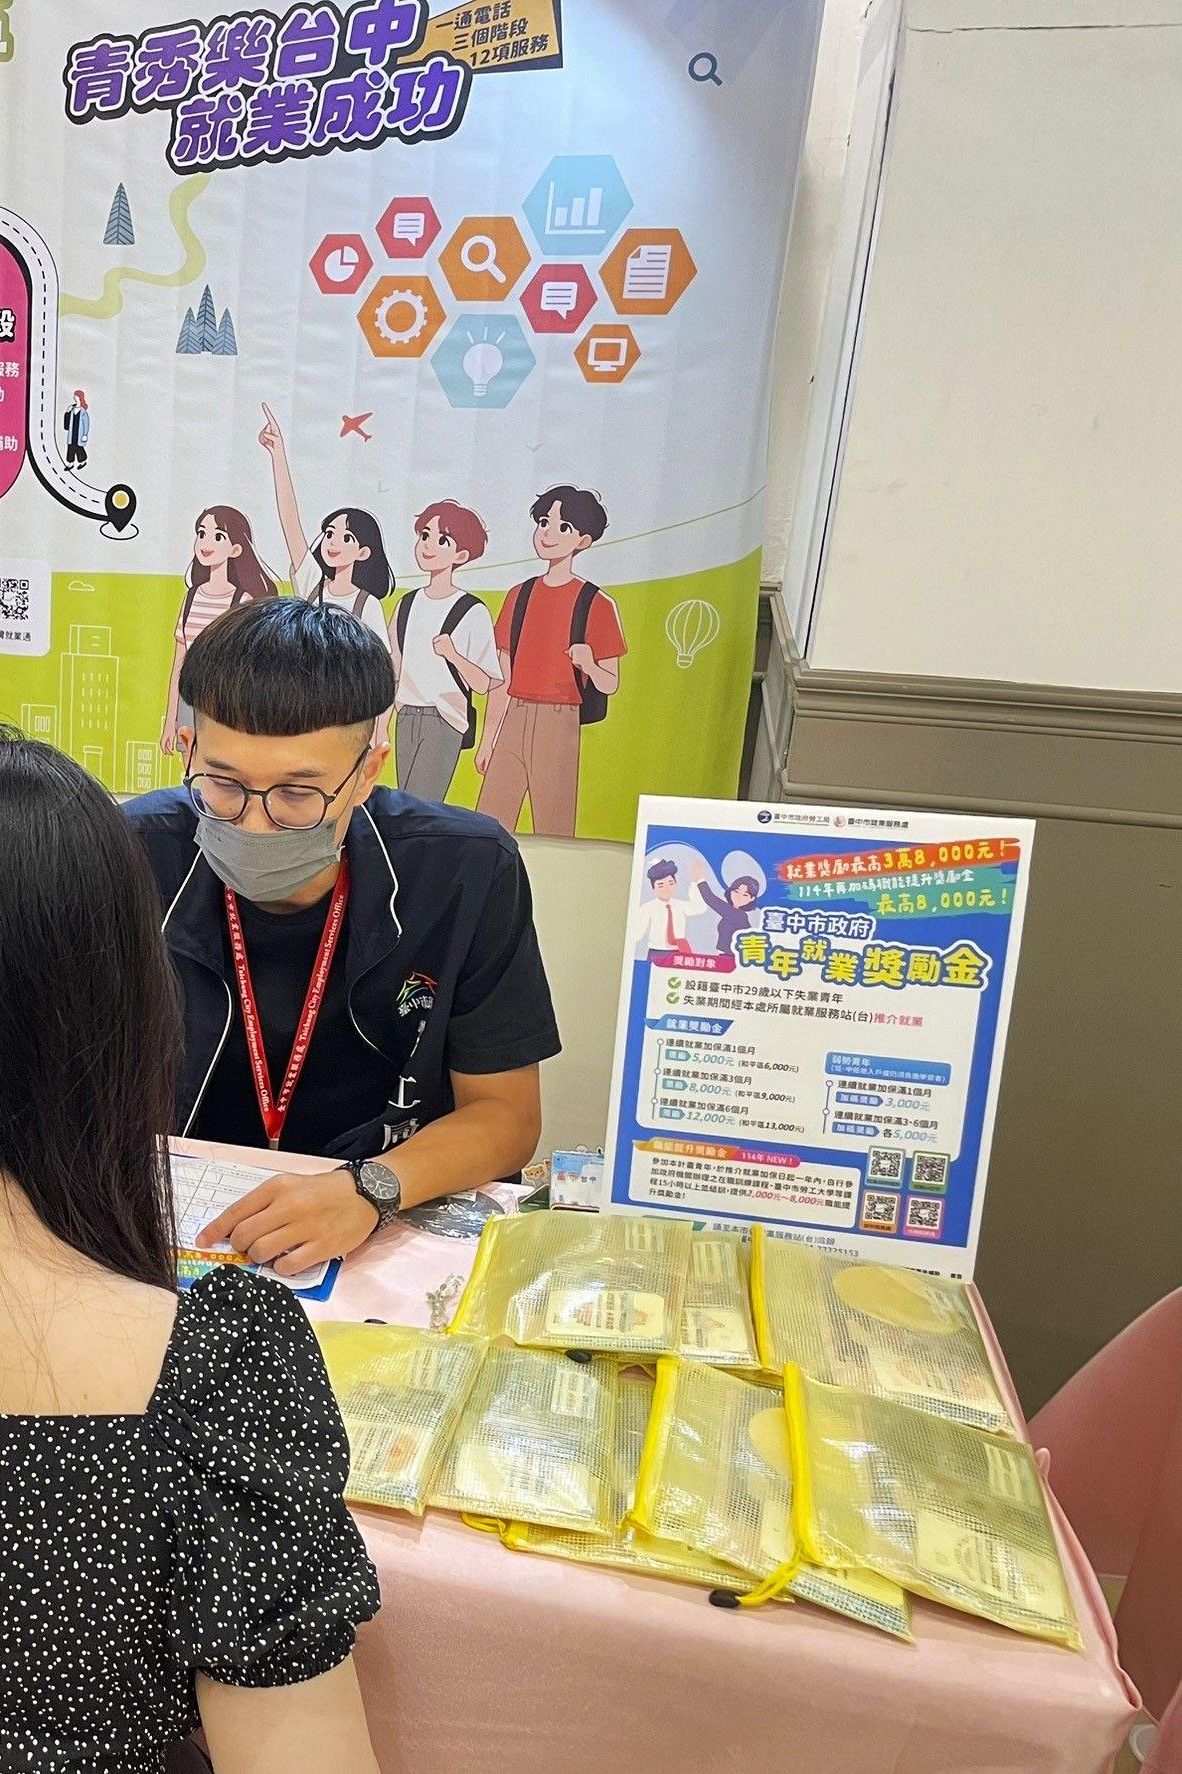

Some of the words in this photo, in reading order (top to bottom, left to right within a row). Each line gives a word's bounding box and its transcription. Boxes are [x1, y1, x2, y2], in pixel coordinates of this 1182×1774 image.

[436, 1, 511, 30] 一通電話
[452, 18, 529, 51] 三個階段
[69, 0, 421, 114] 青秀樂台中
[470, 34, 549, 66] 12項服務
[173, 60, 465, 164] 就業成功
[763, 910, 872, 938] 臺中市政府
[737, 933, 985, 987] 青年就業獎勵金
[685, 979, 844, 1004] 設籍臺中市29歲以下失業青年
[666, 1038, 755, 1055] 連續就業加保滿1個月
[663, 1067, 752, 1085] 連續就業加保滿3個月
[838, 1080, 932, 1098] 連續就業加保滿1個月
[660, 1097, 749, 1115] 連續就業加保滿6個月
